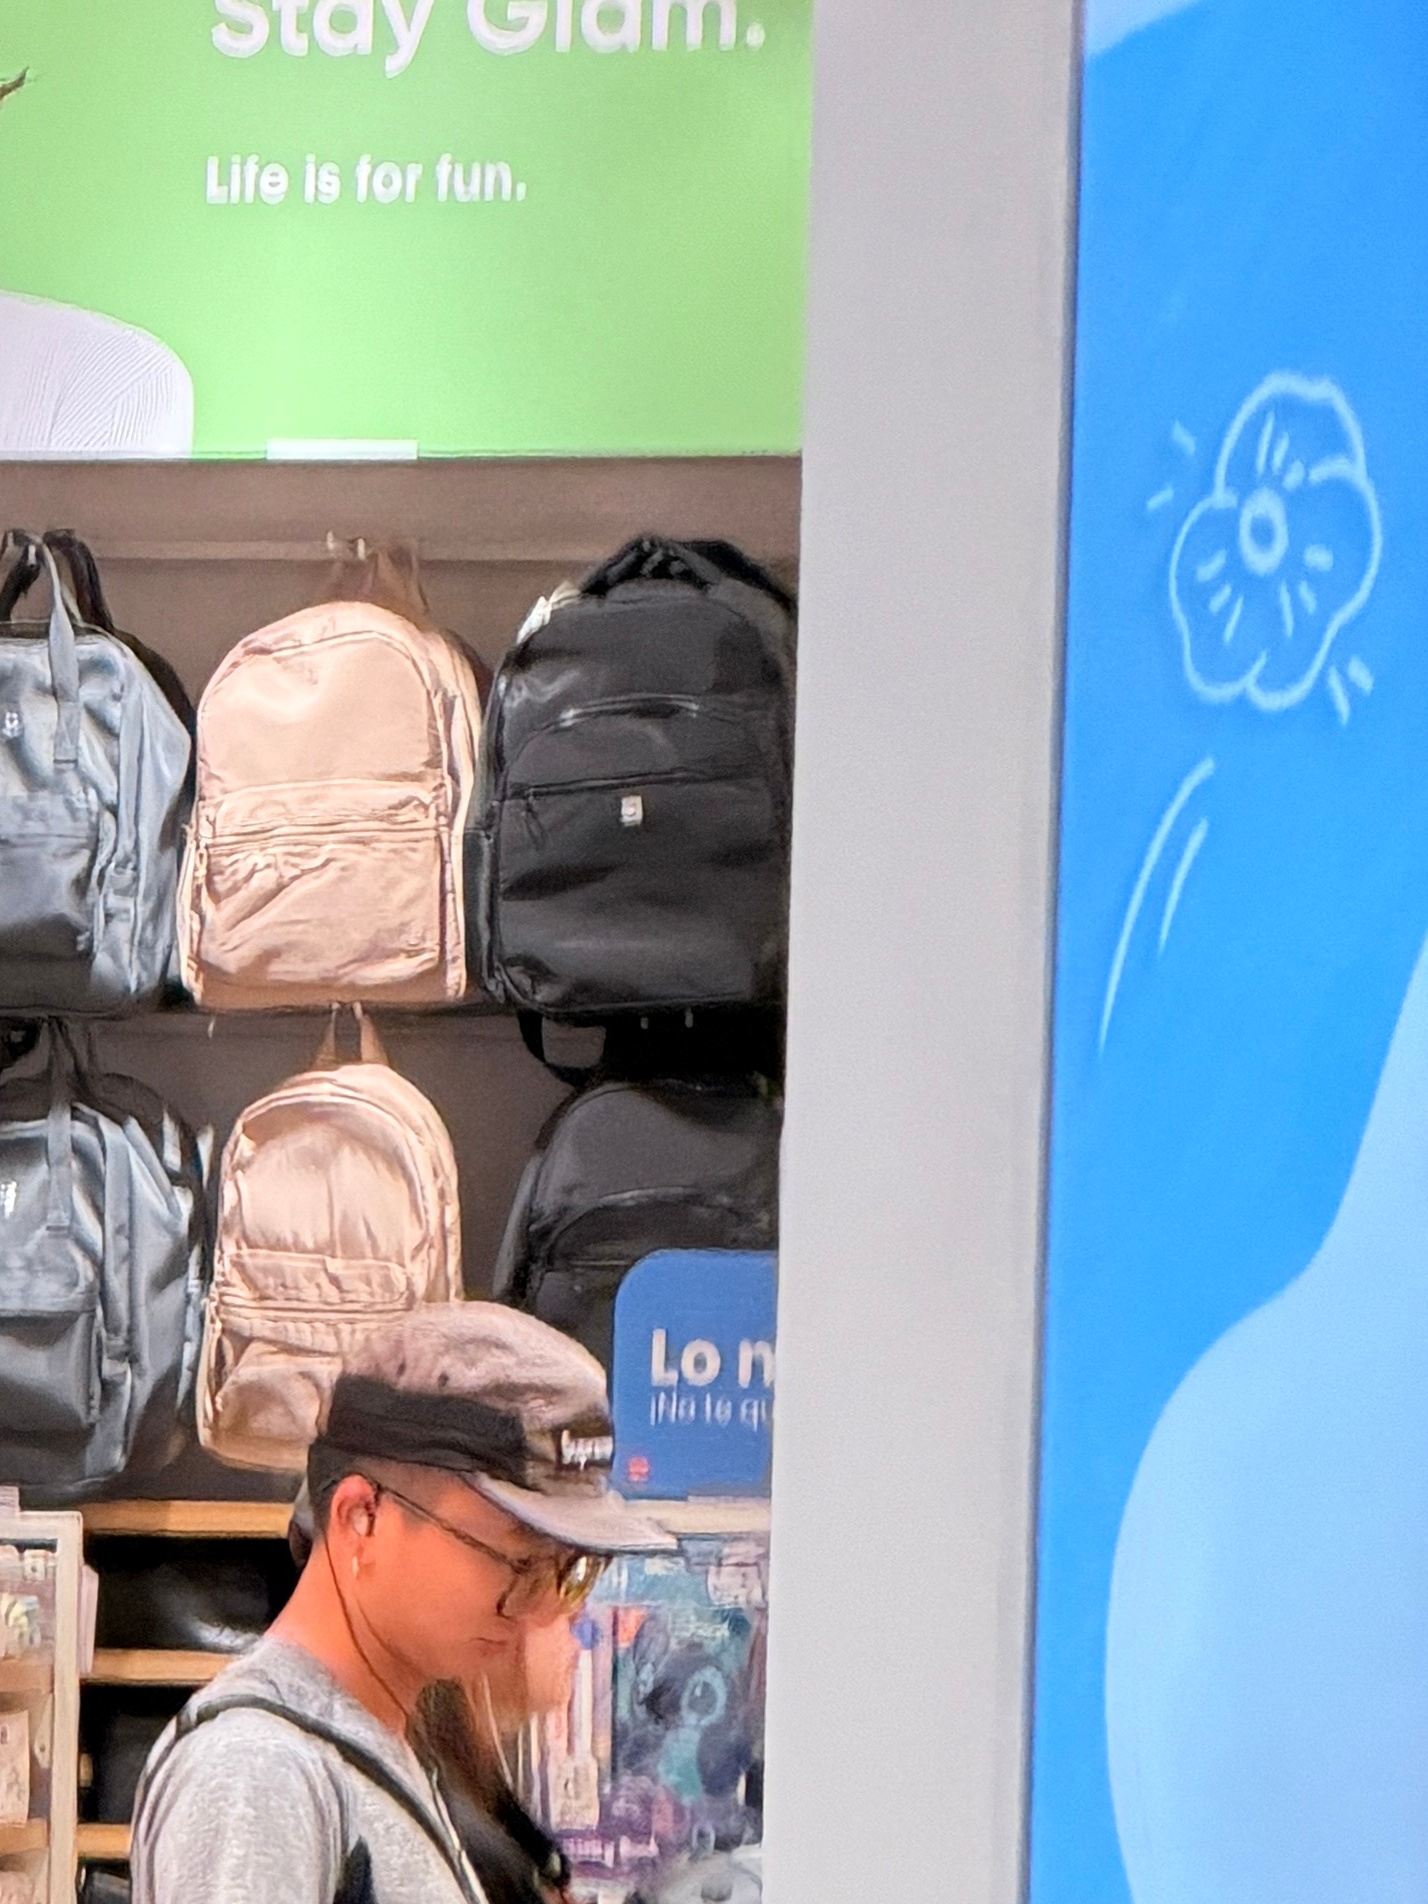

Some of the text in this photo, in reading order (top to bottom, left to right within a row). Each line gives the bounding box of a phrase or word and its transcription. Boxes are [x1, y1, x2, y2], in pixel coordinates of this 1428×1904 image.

[212, 0, 766, 78] Stay Glam.
[206, 154, 528, 204] Life is for fun.
[651, 1328, 721, 1387] Lo
